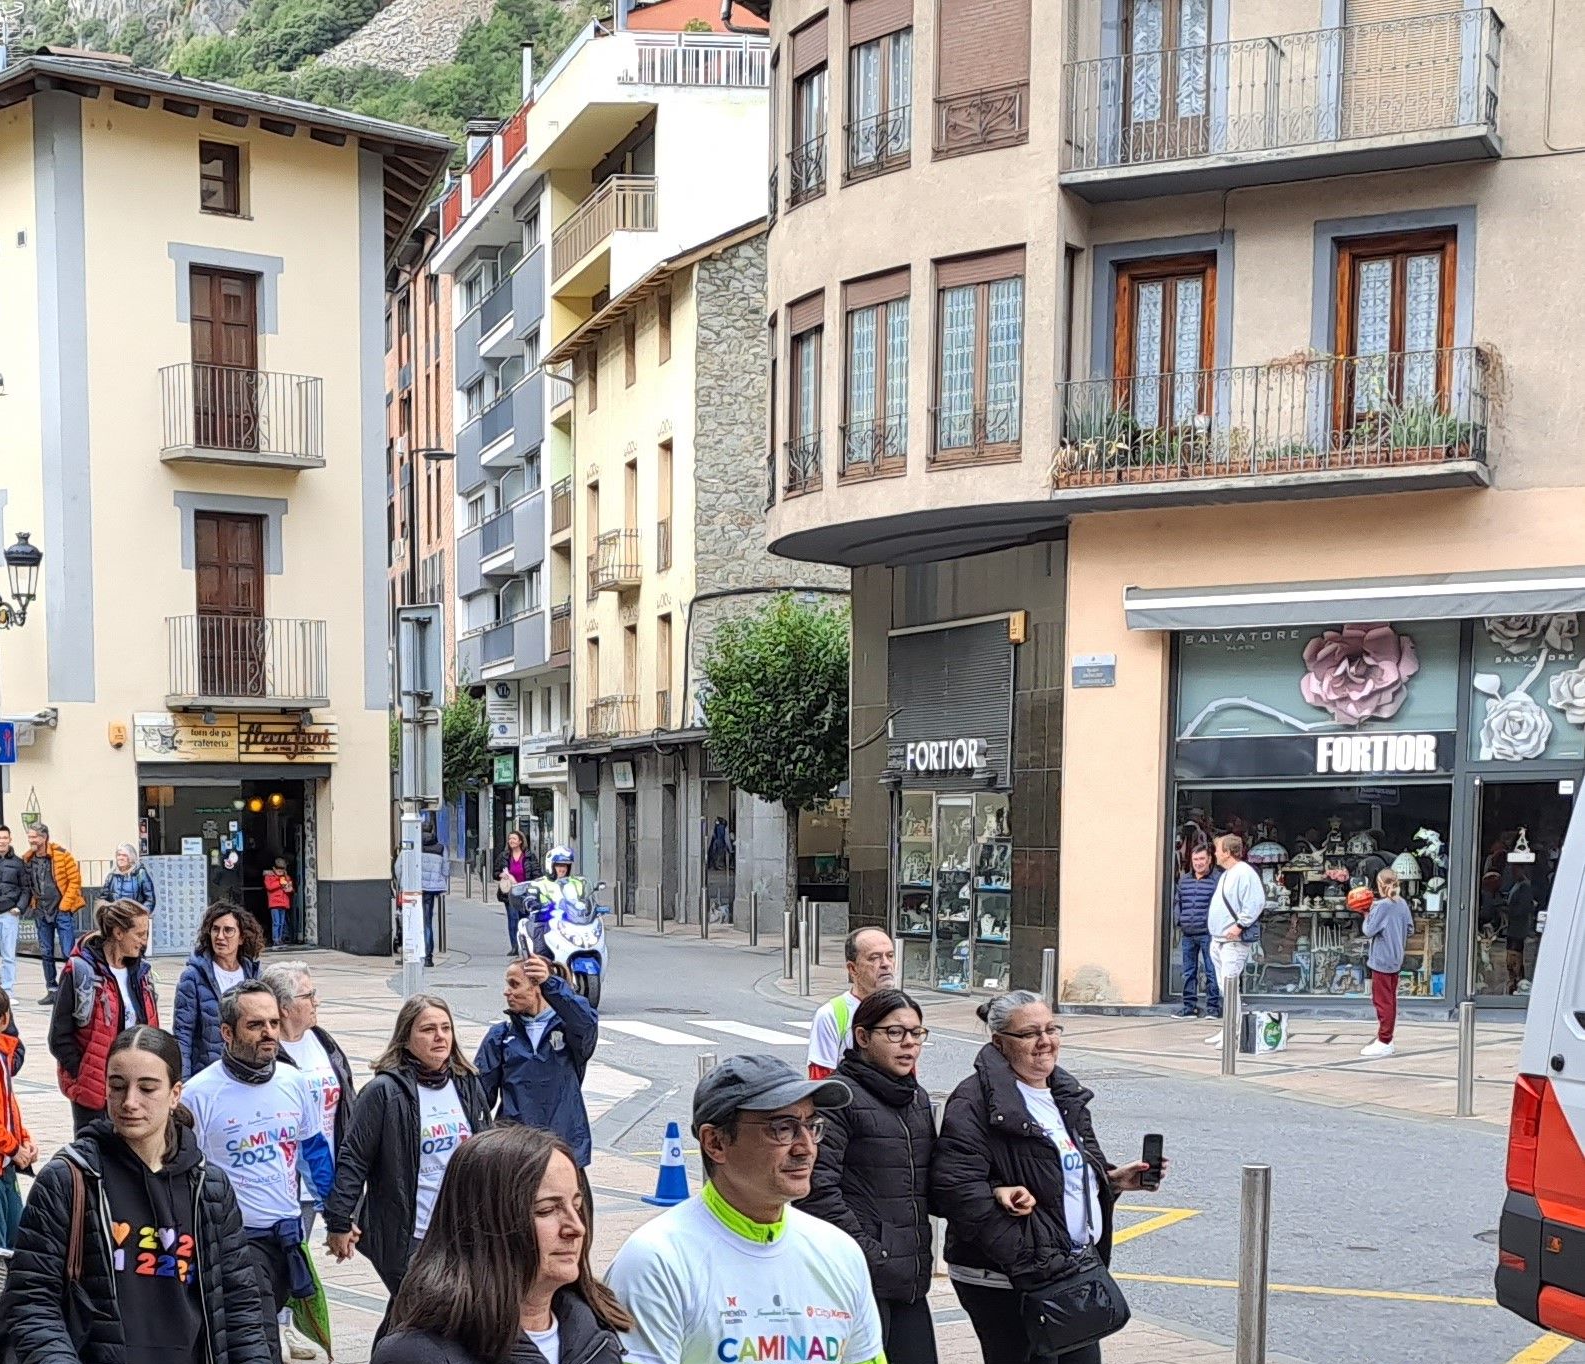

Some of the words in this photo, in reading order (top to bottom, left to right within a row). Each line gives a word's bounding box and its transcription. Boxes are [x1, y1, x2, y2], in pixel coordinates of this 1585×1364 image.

[1185, 630, 1300, 645] SALVATORE
[1495, 653, 1575, 664] SALVAORE
[906, 738, 980, 771] FORTIOR
[1317, 734, 1436, 773] FORTIOR
[229, 1144, 277, 1169] 2023
